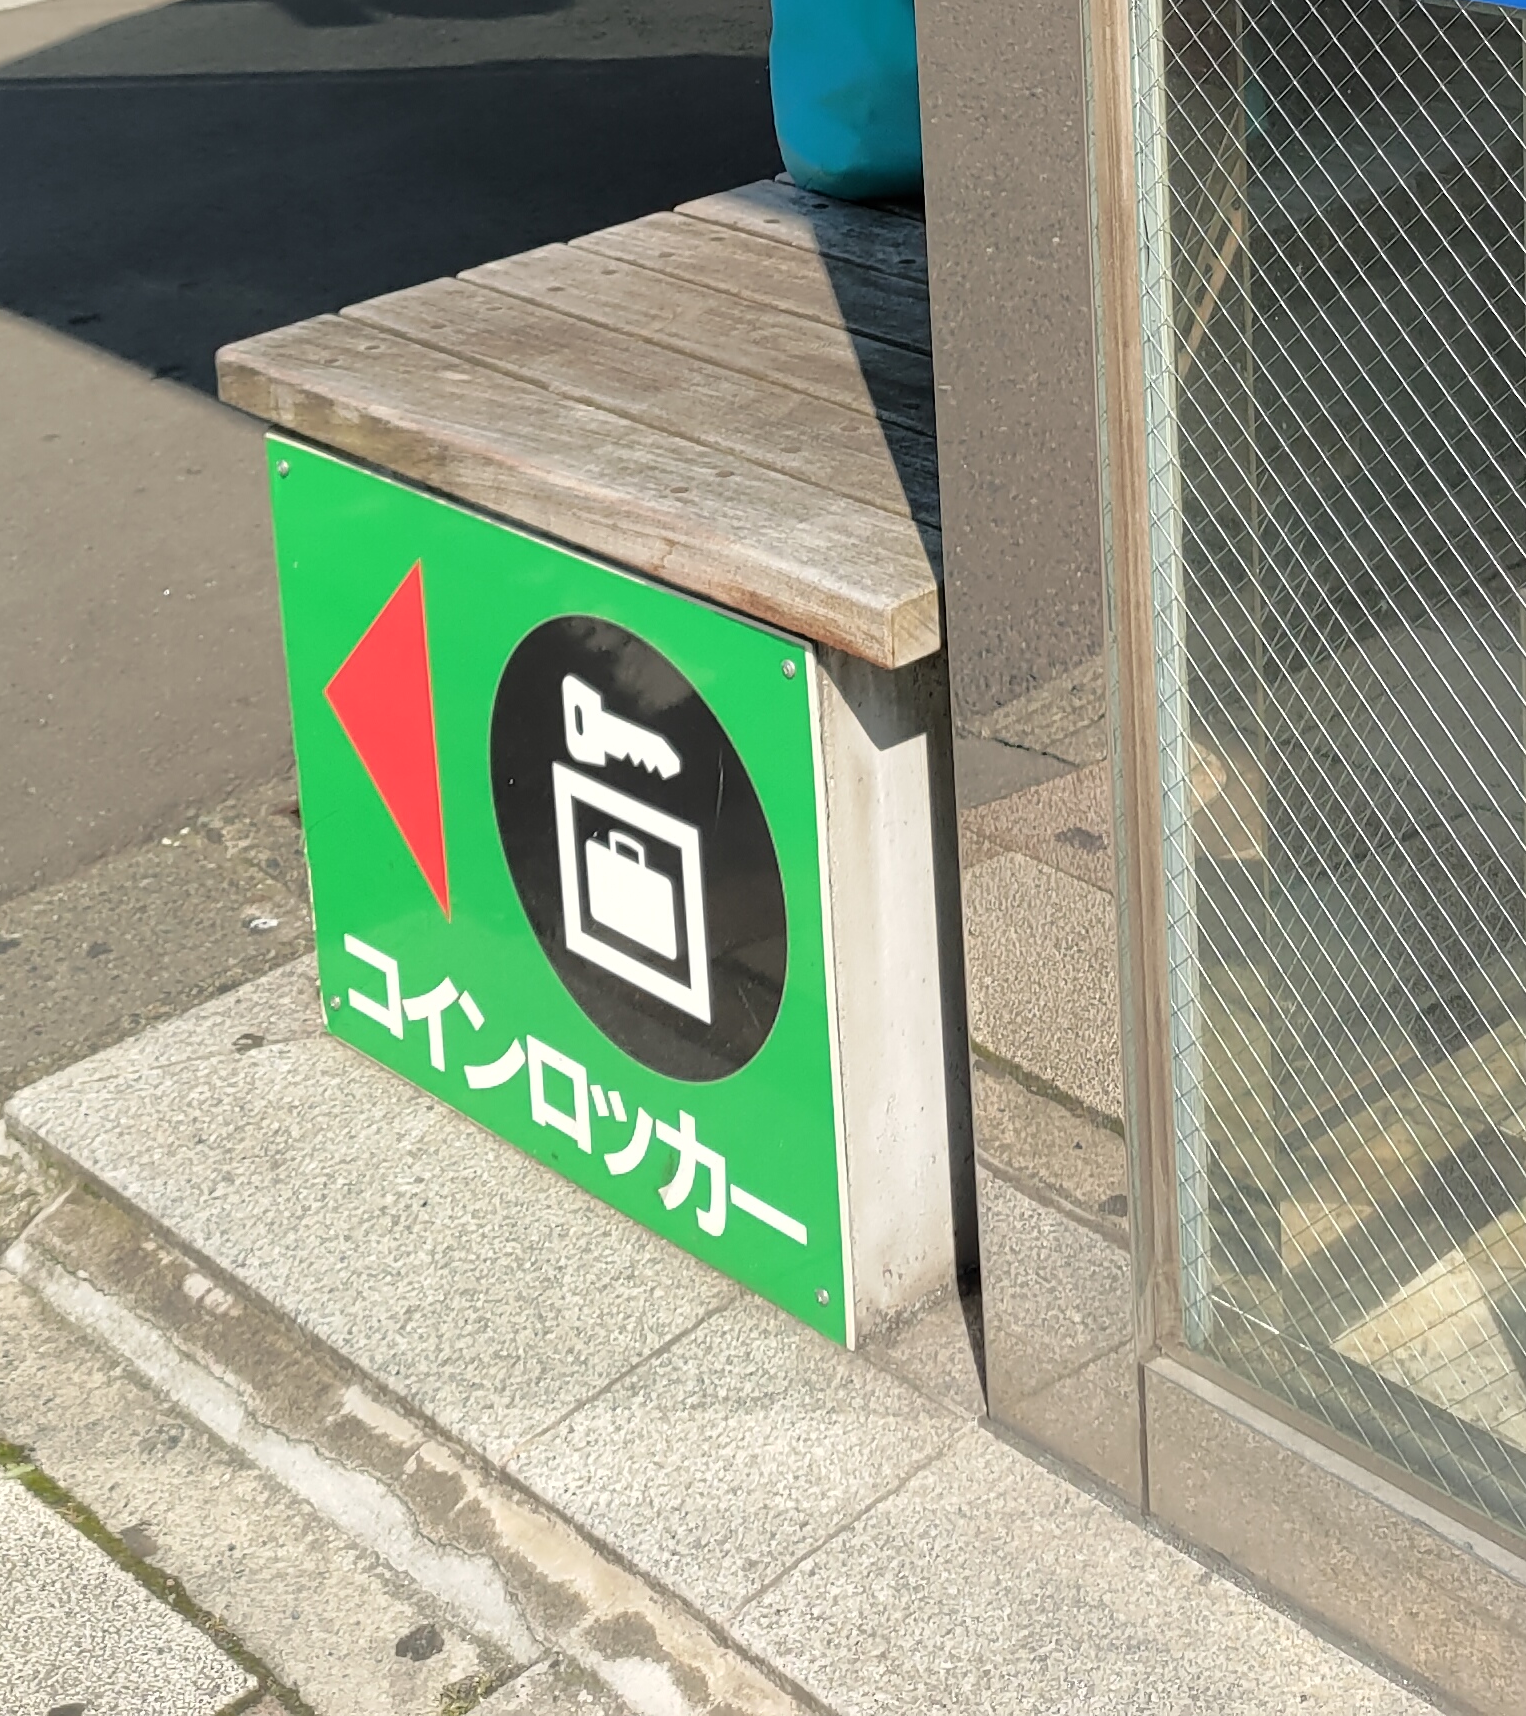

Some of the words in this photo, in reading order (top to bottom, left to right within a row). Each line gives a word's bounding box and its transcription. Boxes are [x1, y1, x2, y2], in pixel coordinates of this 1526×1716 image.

[342, 932, 809, 1247] コインロッカー
